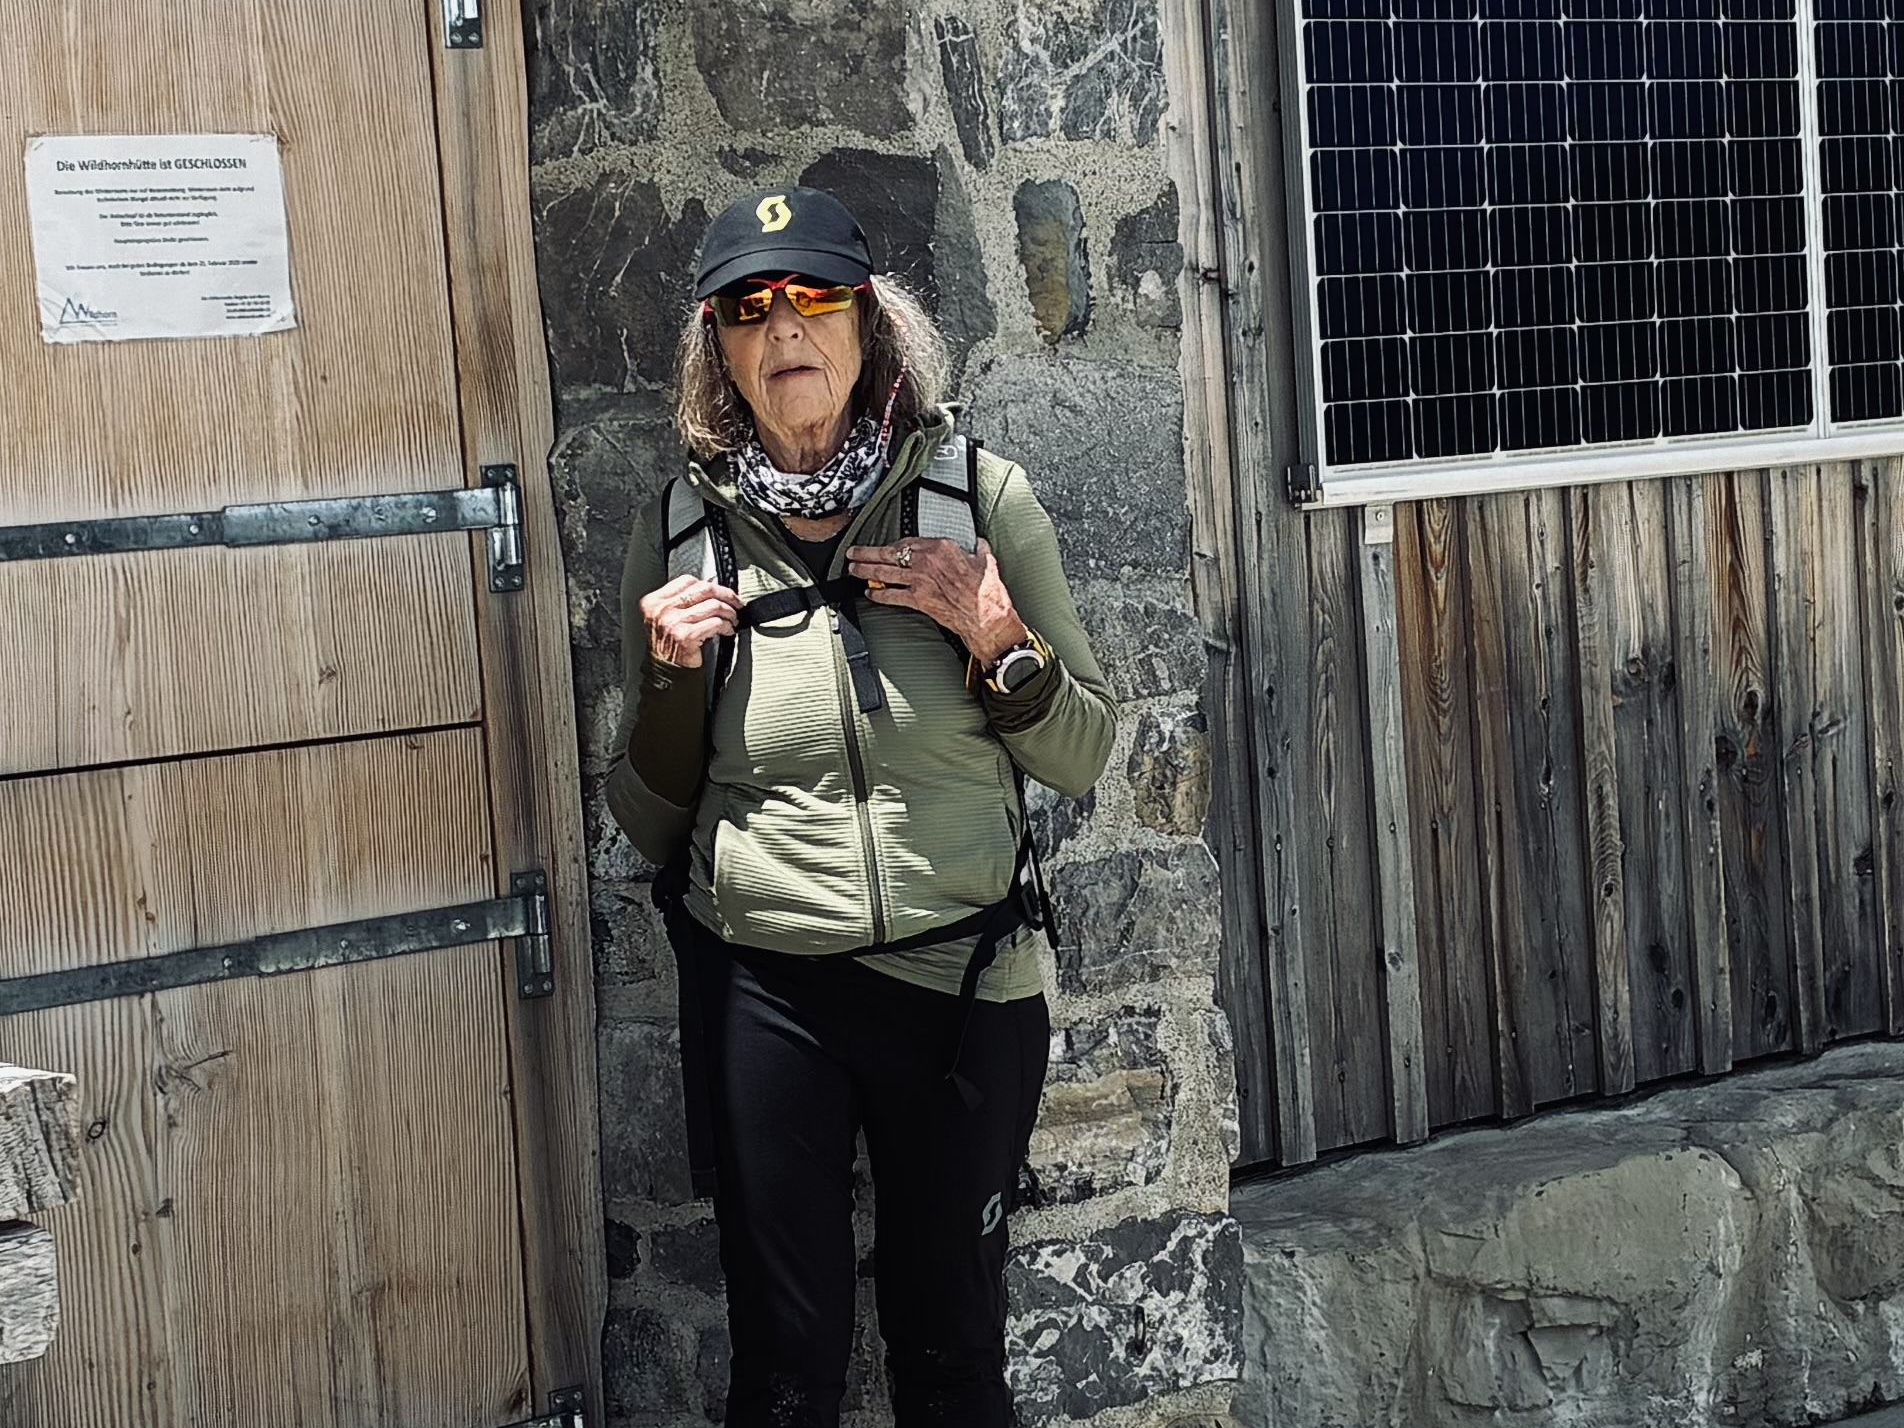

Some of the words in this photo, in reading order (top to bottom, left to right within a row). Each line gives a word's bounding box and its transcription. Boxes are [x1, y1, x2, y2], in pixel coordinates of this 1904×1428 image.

[56, 160, 76, 172] Die
[78, 159, 157, 171] Wildhornhütte
[159, 158, 172, 170] ist
[174, 158, 247, 170] GESCHLOSSEN
